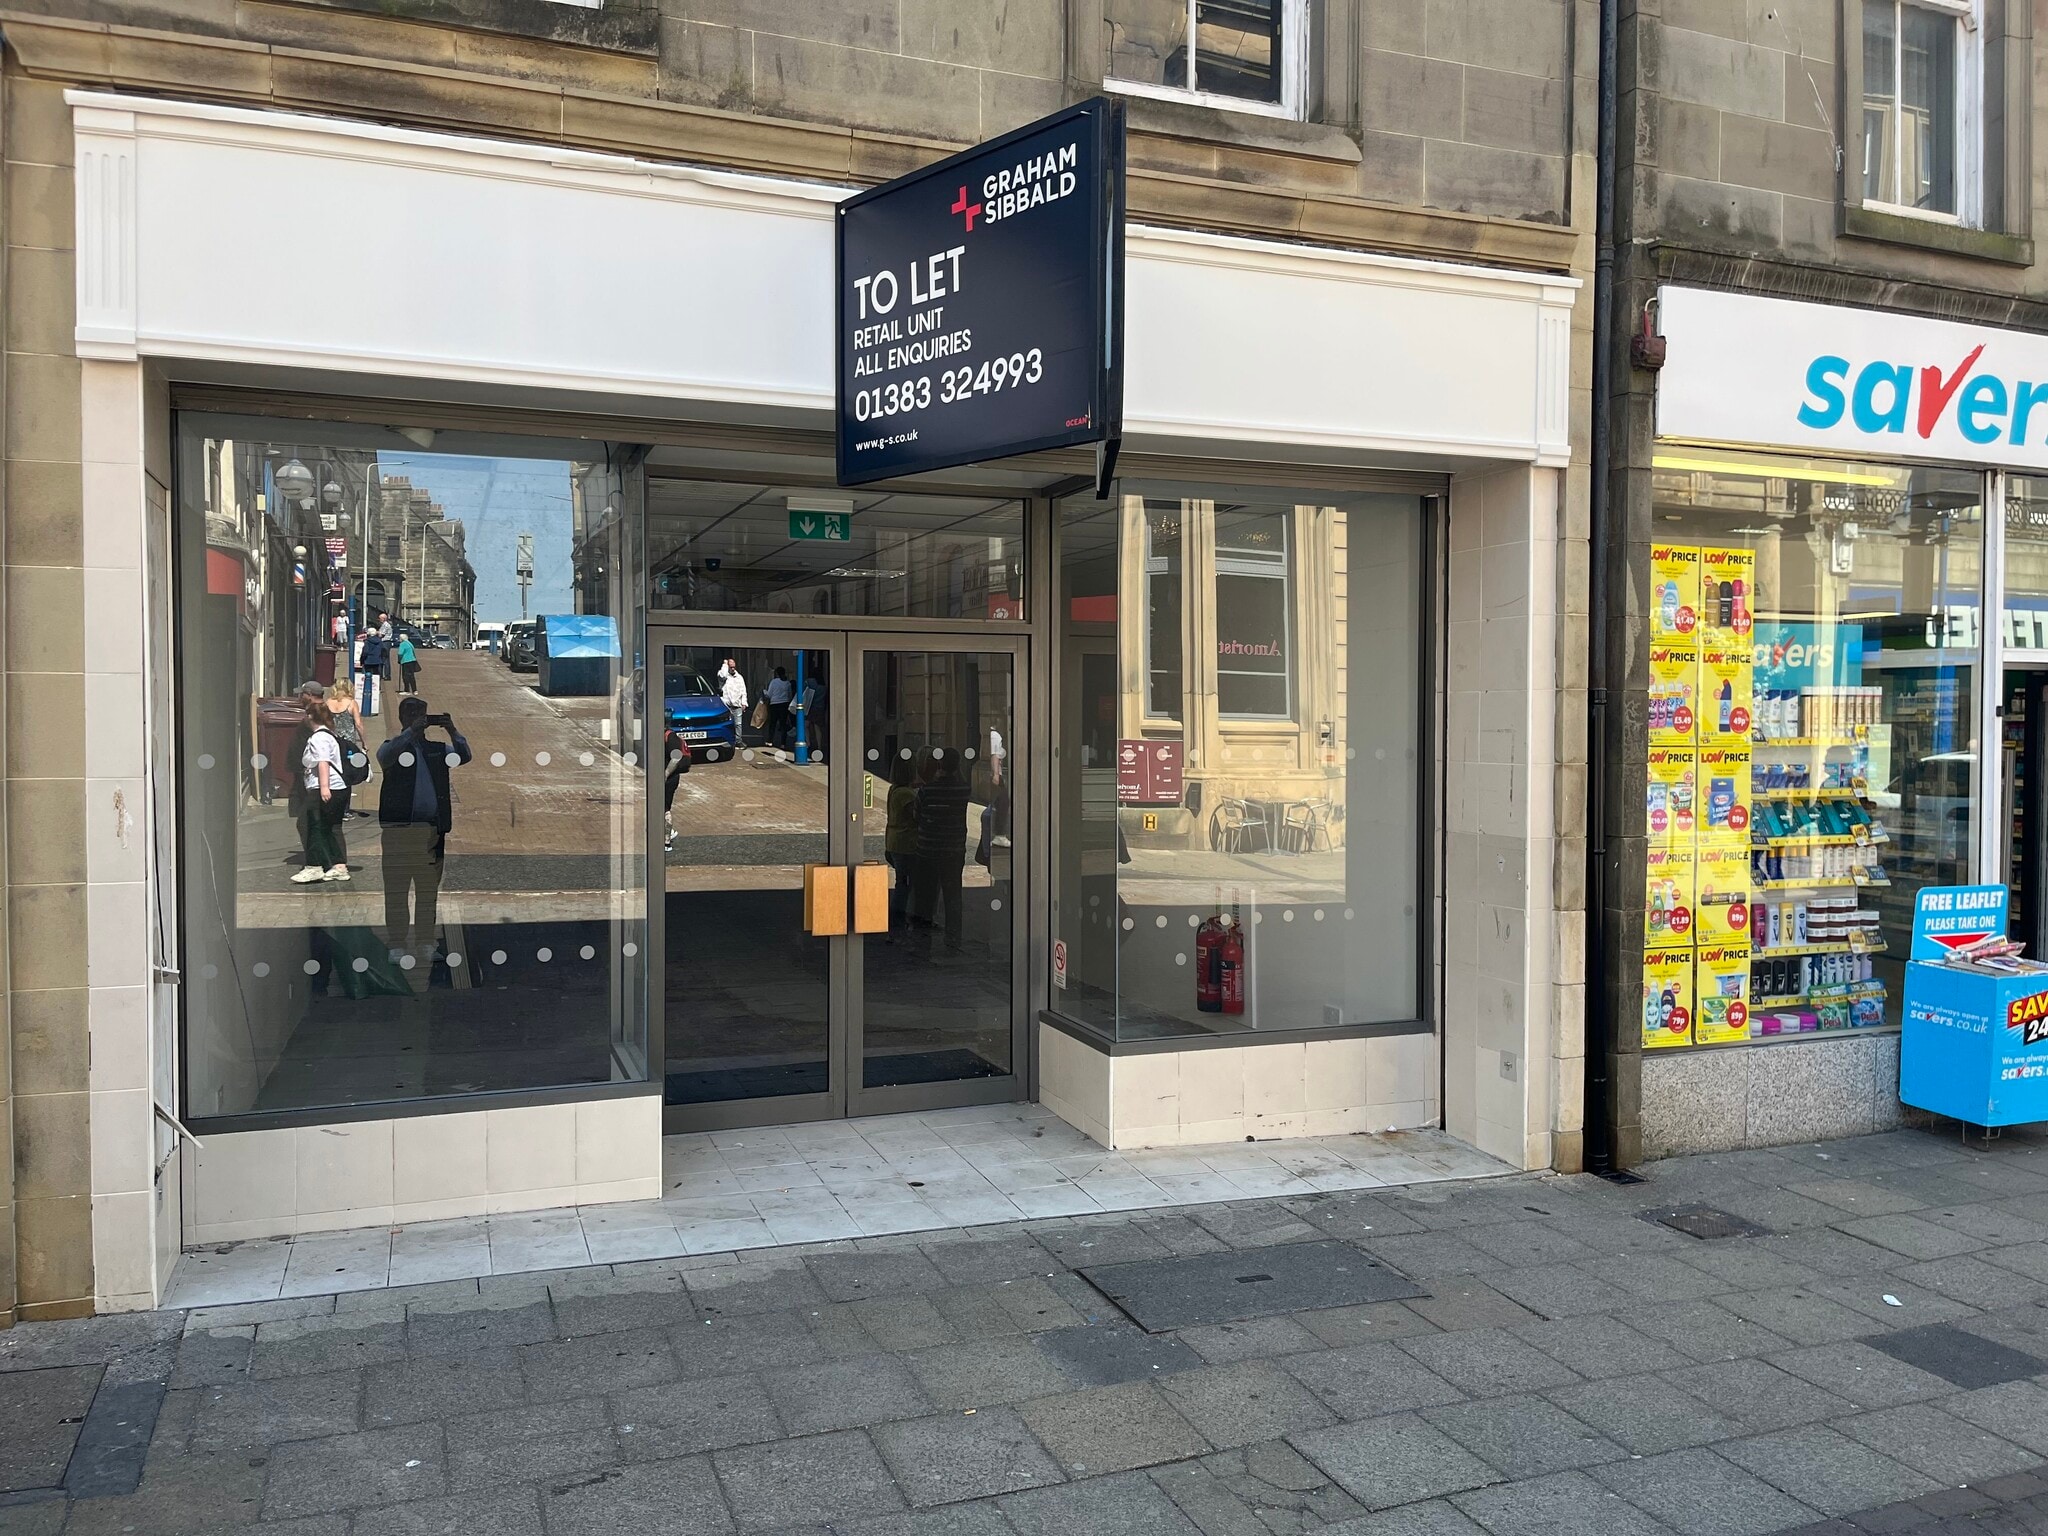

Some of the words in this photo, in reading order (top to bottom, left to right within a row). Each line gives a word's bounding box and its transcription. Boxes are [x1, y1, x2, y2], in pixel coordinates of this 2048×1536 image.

[983, 144, 1076, 199] GRAHAM
[985, 172, 1076, 224] SIBBALD
[854, 270, 898, 320] TO
[910, 246, 965, 306] LET
[854, 318, 902, 350] RETAIL
[908, 307, 944, 337] UNIT
[854, 347, 882, 378] ALL
[888, 329, 972, 370] ENQUIRIES
[855, 376, 930, 422] 01383
[940, 348, 1042, 404] 324993
[1797, 344, 2048, 446] saver
[1066, 416, 1087, 427] OCEAN
[856, 430, 918, 452] www.g-s.co.uk
[1672, 552, 1697, 562] PRICE
[1704, 552, 1728, 564] LOW
[1728, 556, 1752, 565] PRICE
[1650, 649, 1670, 662] OW
[1670, 652, 1696, 663] PRICE
[1726, 654, 1750, 664] PRICE
[1752, 636, 1833, 668] avers
[1734, 718, 1746, 727] 49p
[1648, 750, 1668, 763] OW
[1668, 754, 1694, 764] PRICE
[1701, 750, 1725, 763] LOW
[1724, 753, 1750, 764] PRICE
[1732, 816, 1744, 824] 89p
[1648, 851, 1667, 864] OW
[1666, 854, 1692, 865] PRICE
[1700, 849, 1724, 864] LOW
[1724, 852, 1749, 863] PRICE
[1922, 894, 1952, 912] FREE
[1956, 891, 2004, 910] LEAFLET
[1732, 914, 1744, 922] 89p
[1925, 918, 1956, 930] PLEASE
[1958, 916, 1978, 928] TAKE
[1980, 915, 1996, 928] ONE
[1666, 954, 1691, 965] PRICE
[1700, 948, 1724, 962] LOW
[1724, 950, 1749, 962] PRICE
[1730, 1012, 1743, 1020] 89p
[1910, 1000, 1922, 1008] We
[1936, 1006, 1960, 1018] always
[1962, 1012, 1980, 1022] open
[1672, 1017, 1686, 1026] 79p
[1910, 1010, 1988, 1034] savers.co.uk
[2002, 1056, 2012, 1065] We
[2001, 1064, 2048, 1080] savers.
